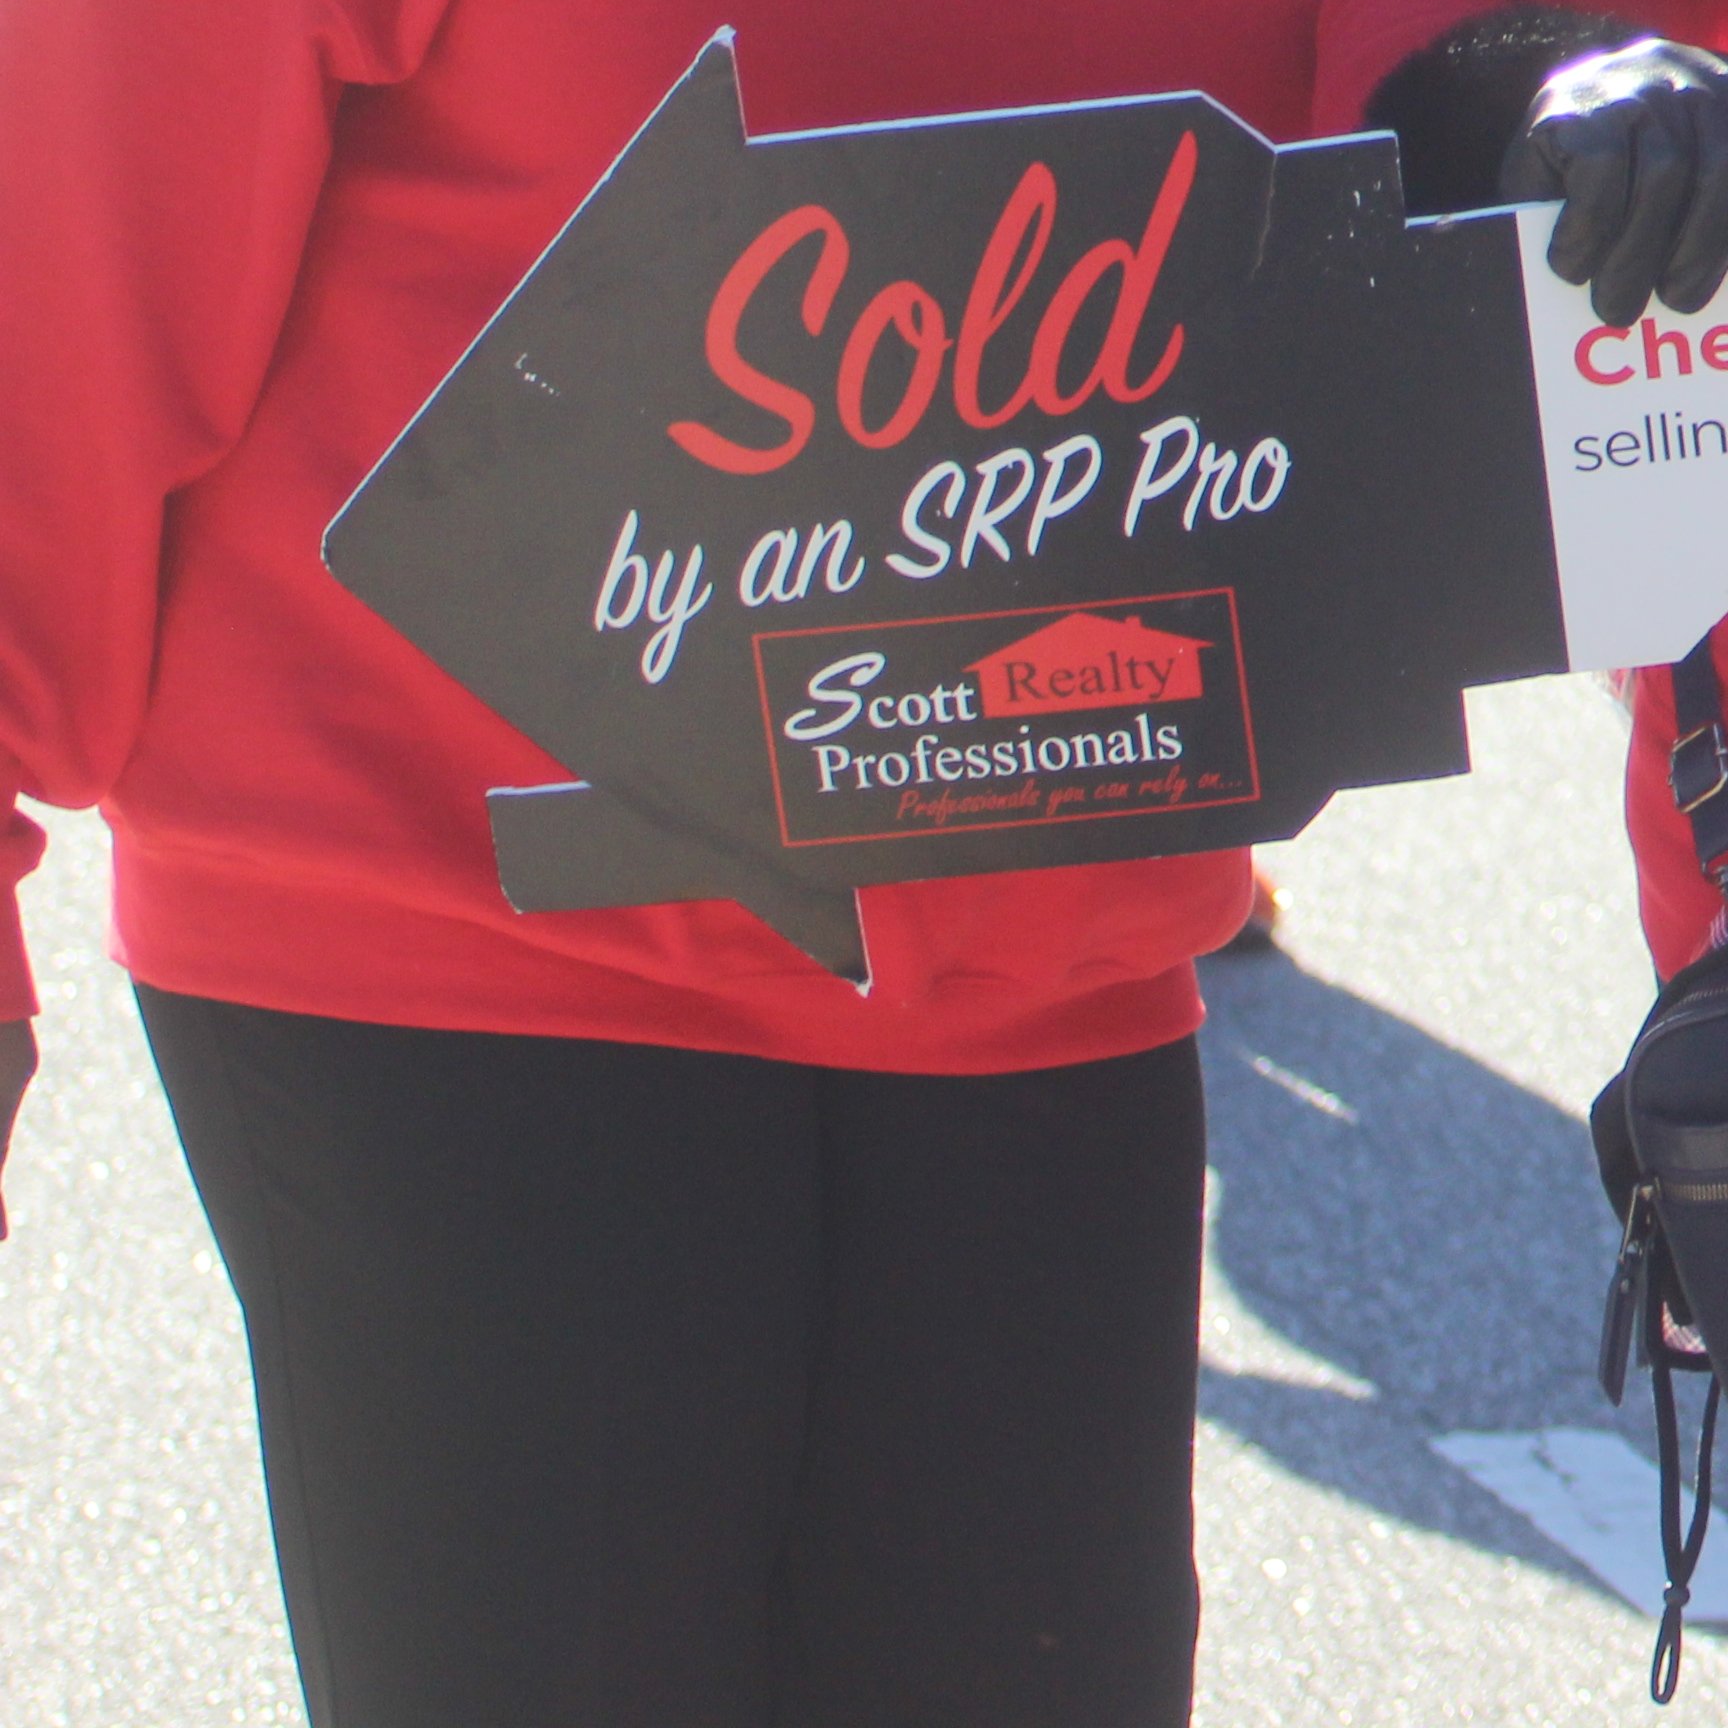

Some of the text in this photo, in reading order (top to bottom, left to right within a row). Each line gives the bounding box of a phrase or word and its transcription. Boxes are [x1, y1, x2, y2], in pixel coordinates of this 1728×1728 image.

[667, 130, 1198, 474] Sold
[594, 415, 1290, 684] by an SRP Pro
[784, 650, 1176, 740] Scott Realty
[811, 712, 1183, 793] Professionals
[896, 778, 1040, 825] Professionals
[1046, 787, 1085, 816] you
[1094, 782, 1130, 799] can
[1139, 765, 1188, 804] rely
